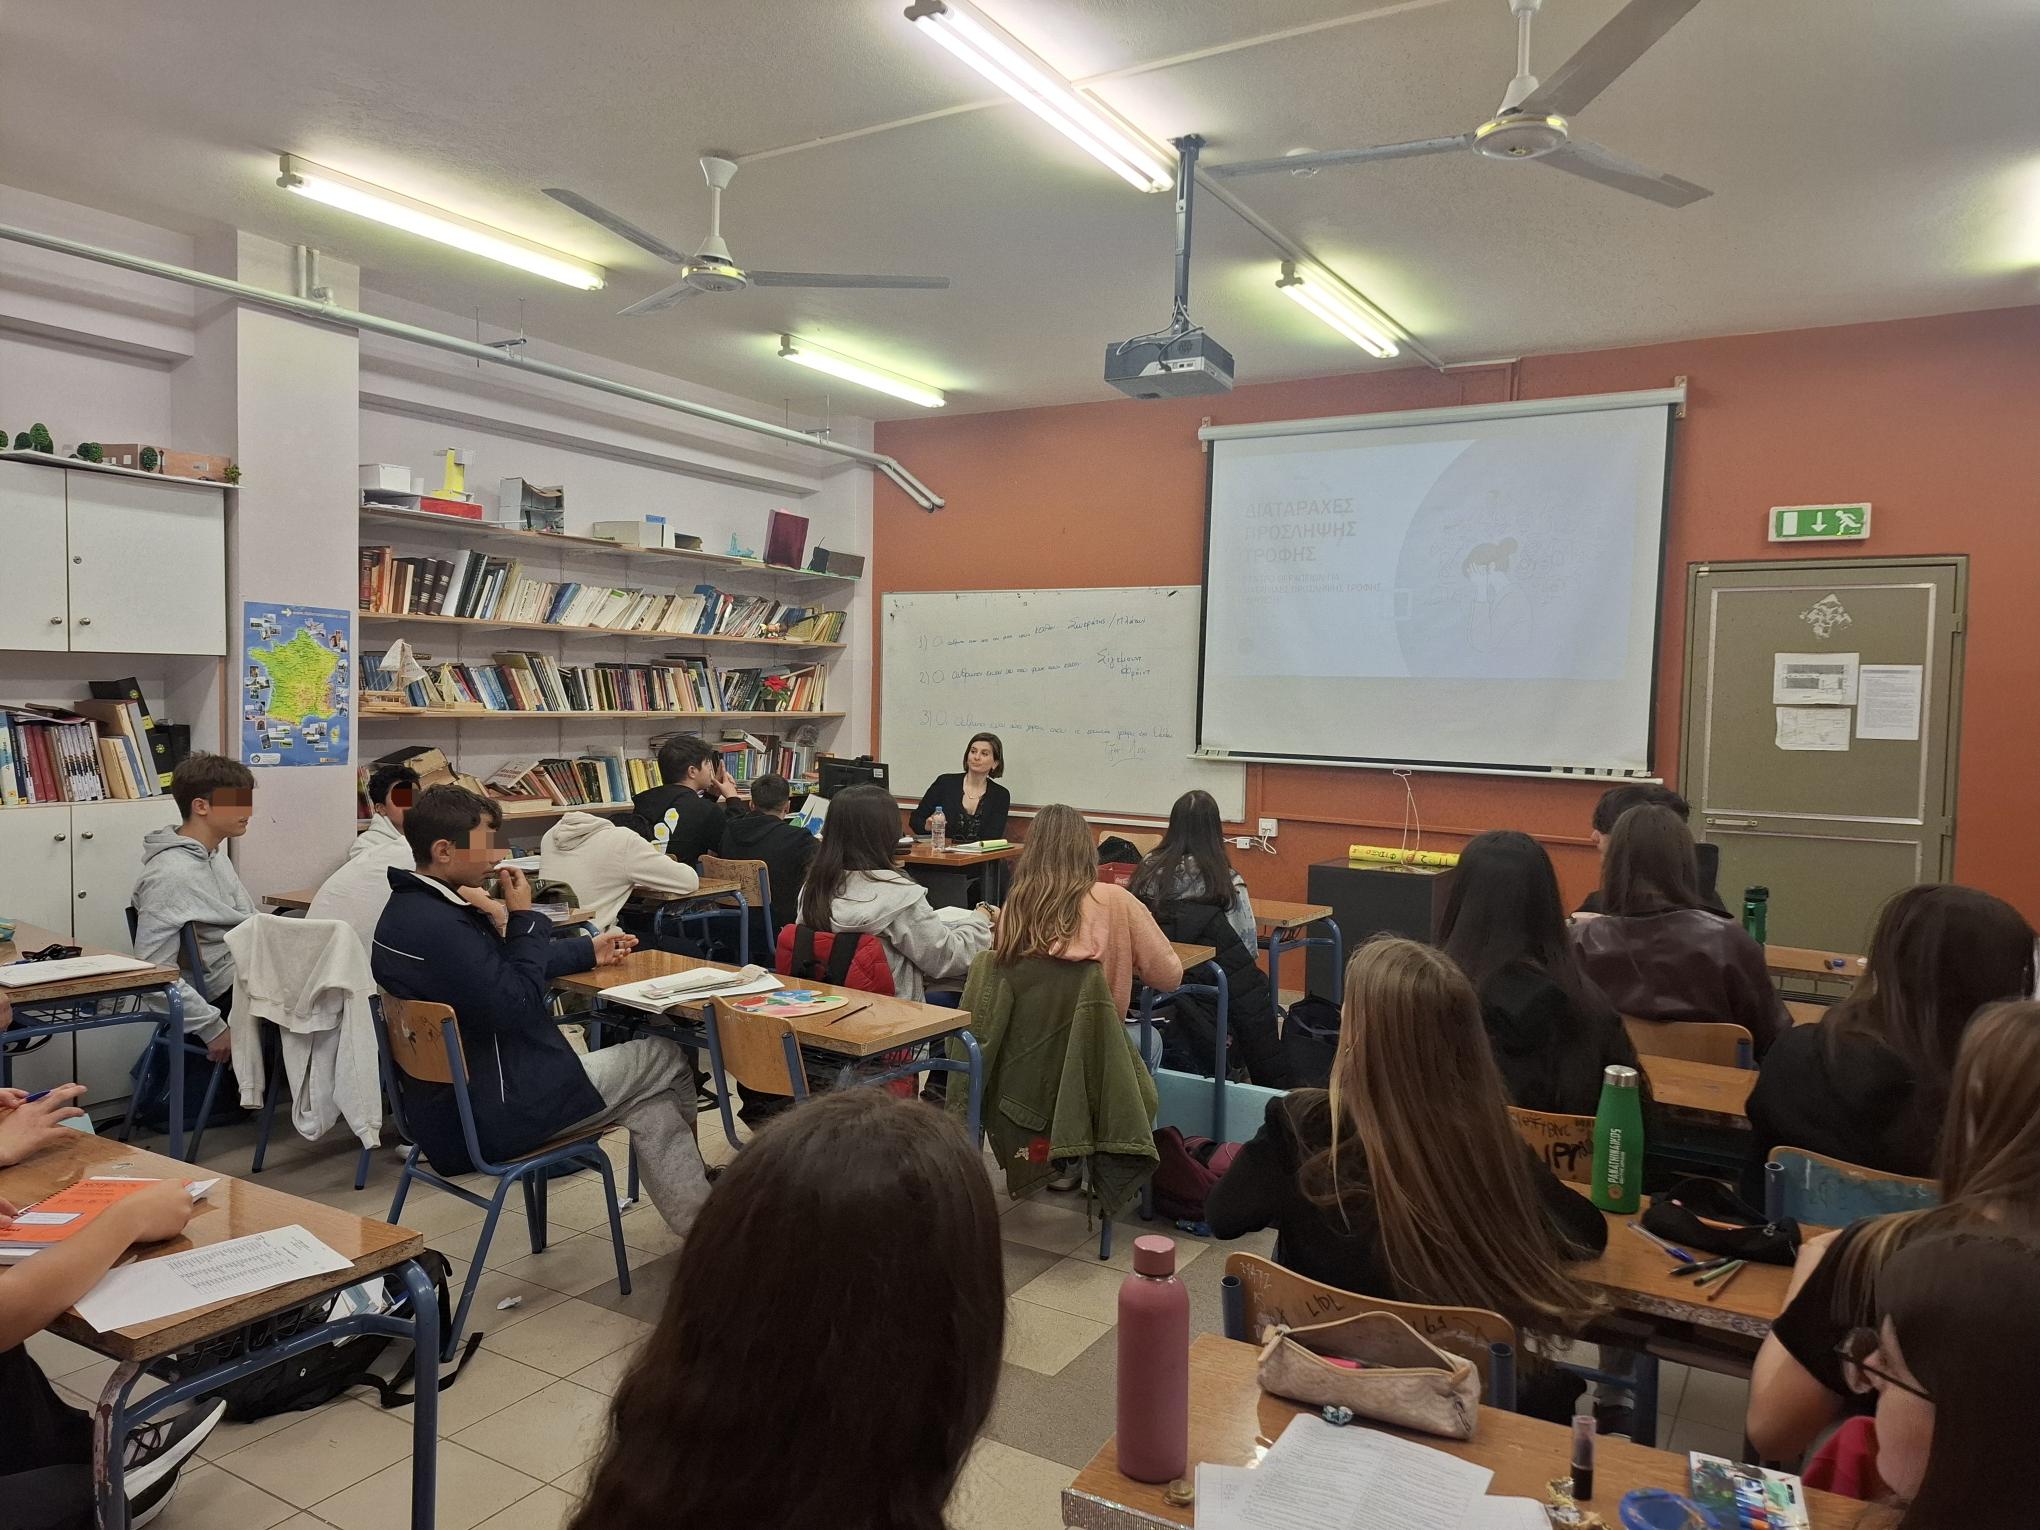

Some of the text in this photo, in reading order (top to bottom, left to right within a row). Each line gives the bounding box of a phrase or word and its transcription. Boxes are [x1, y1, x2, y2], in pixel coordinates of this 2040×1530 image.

[1245, 498, 1354, 518] ΔΙΑΤΑΡΑΧΕΣ
[1244, 521, 1357, 540] ΠΡΟΣΛΗΨΗΣ
[1243, 546, 1317, 563] ΤΡΟΦΗΣ
[1607, 1127, 1622, 1184] PANATHINAIKOS
[1305, 1294, 1345, 1317] LIDL
